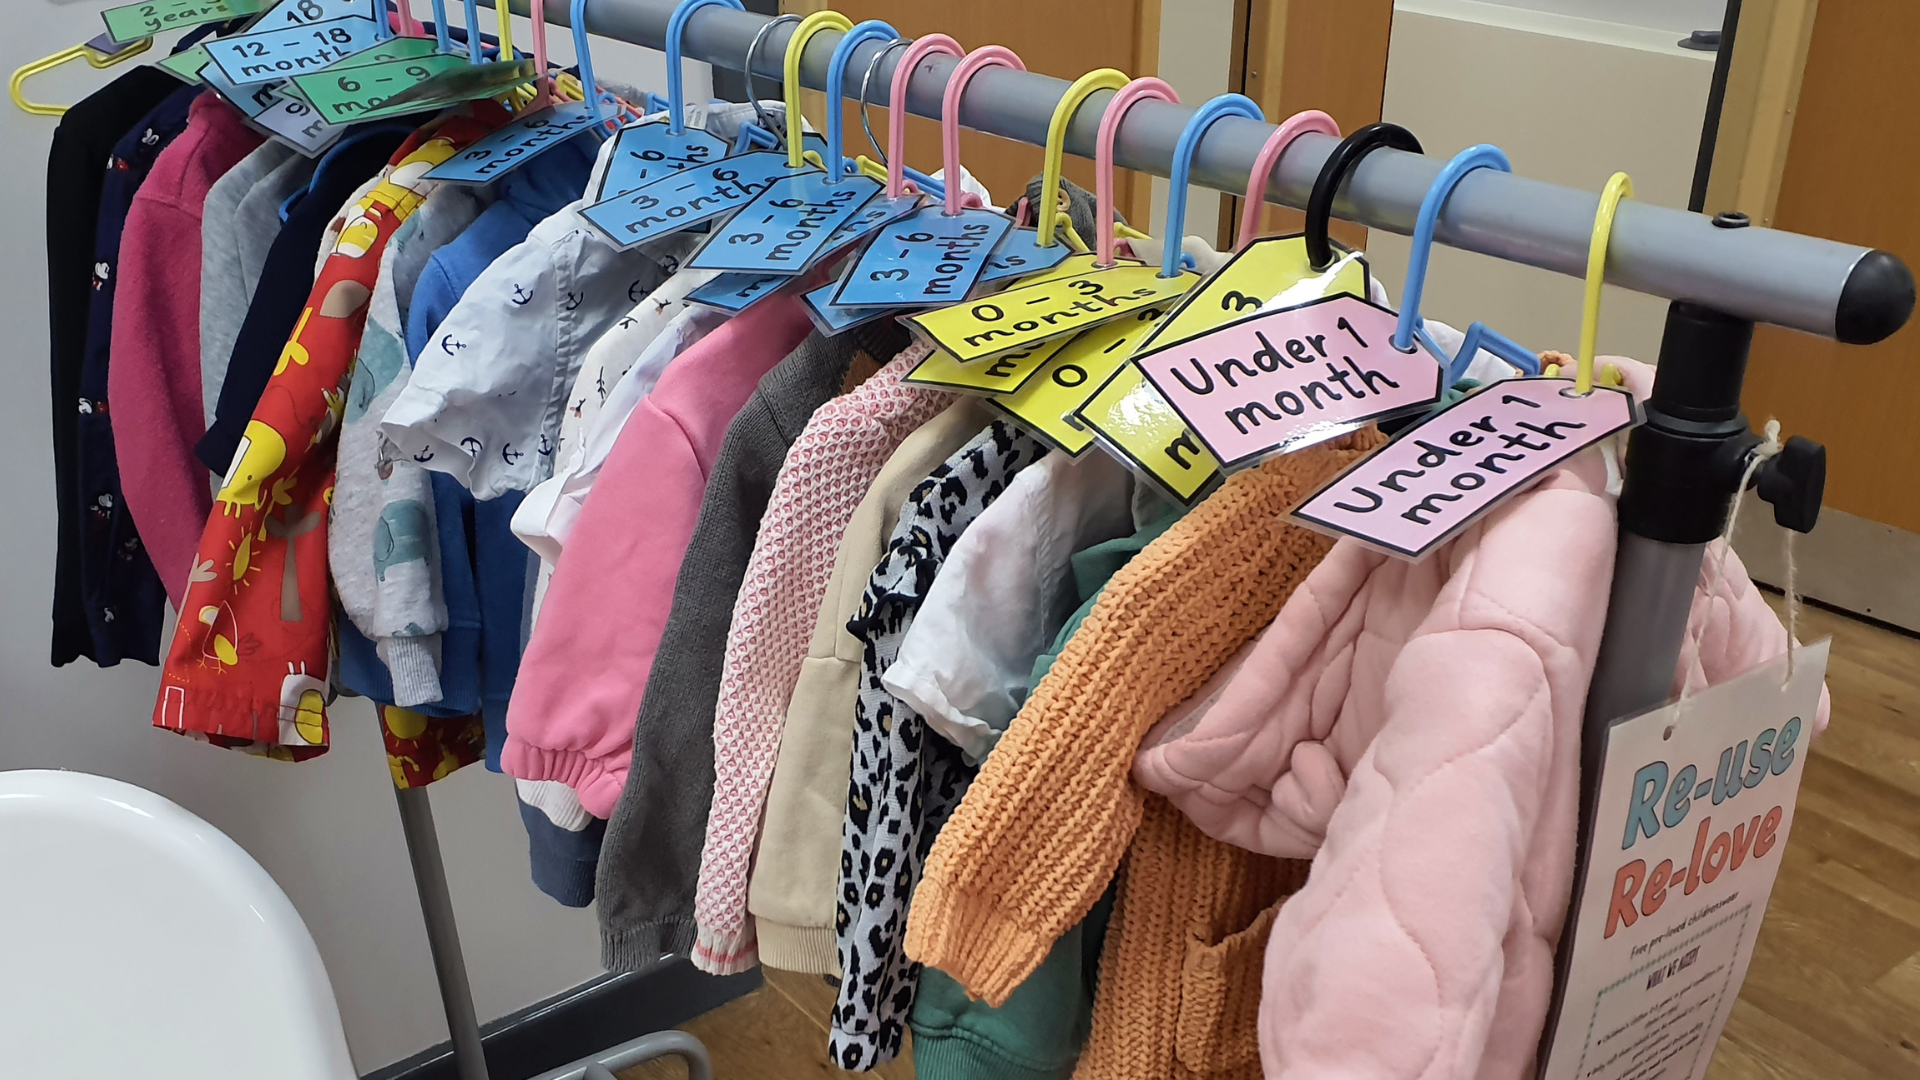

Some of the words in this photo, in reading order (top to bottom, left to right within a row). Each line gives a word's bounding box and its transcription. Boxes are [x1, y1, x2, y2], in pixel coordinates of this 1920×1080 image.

[140, 6, 158, 17] 2
[144, 5, 228, 32] years
[232, 42, 270, 58] 12
[313, 27, 352, 45] 18
[241, 46, 351, 76] mont
[337, 76, 361, 92] 6
[406, 66, 431, 82] 9
[464, 149, 492, 160] 3
[524, 119, 550, 129] 6
[475, 115, 594, 174] months
[630, 149, 665, 161] 6
[631, 195, 660, 210] 3
[712, 167, 739, 181] 6
[728, 232, 765, 245] 3
[769, 198, 804, 209] 6
[765, 190, 857, 261] months
[869, 267, 910, 282] 3
[895, 232, 934, 243] 6
[922, 223, 990, 295] months
[963, 287, 1156, 347] months
[971, 304, 1005, 322] 0
[1068, 279, 1104, 295] 3
[1221, 290, 1263, 312] 3
[1052, 363, 1088, 388] 0
[1169, 330, 1328, 396] Under
[1336, 316, 1369, 349] 1
[1224, 355, 1400, 435] month
[1333, 415, 1498, 514] Under
[1501, 393, 1542, 409] 1
[1400, 410, 1587, 526] month
[1622, 717, 1801, 850] Re-use
[1604, 806, 1783, 940] Re-love
